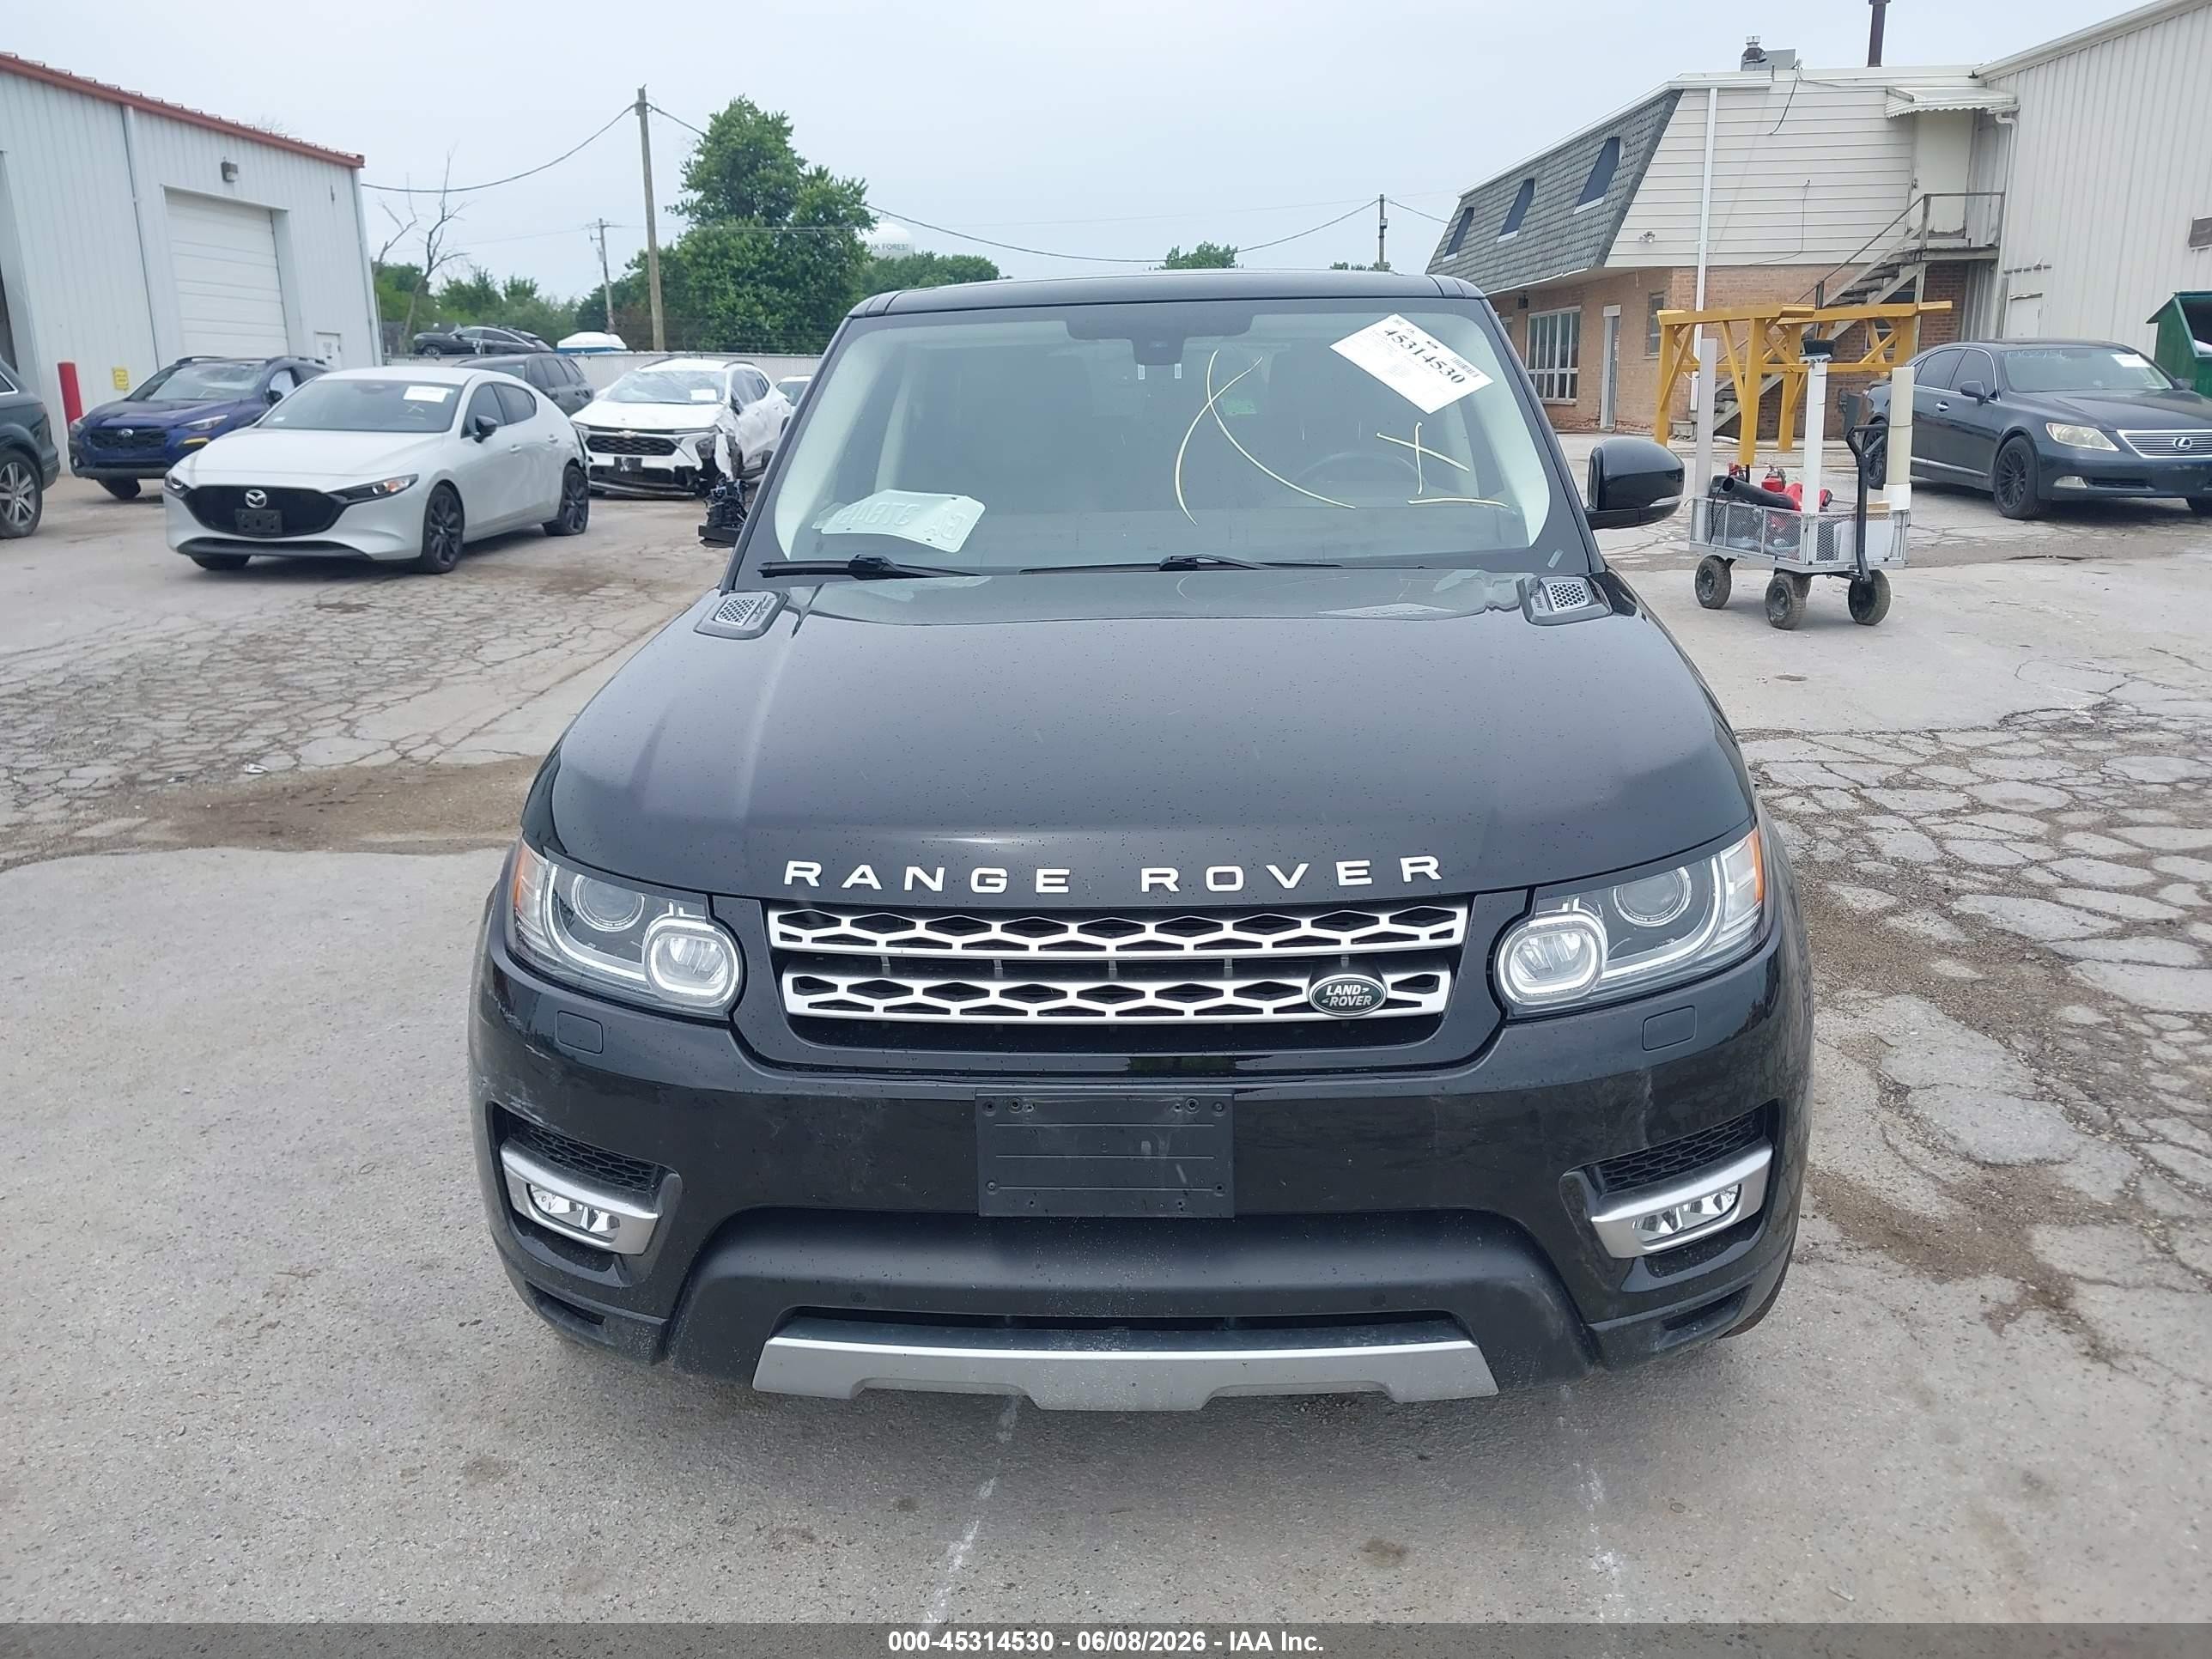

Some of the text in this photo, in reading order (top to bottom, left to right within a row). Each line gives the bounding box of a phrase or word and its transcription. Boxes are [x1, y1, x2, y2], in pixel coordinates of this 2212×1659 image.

[1384, 328, 1466, 384] 45314530
[783, 854, 1443, 895] RANGE ROVER
[1326, 984, 1362, 996] LAND
[1329, 995, 1372, 1006] ROVER
